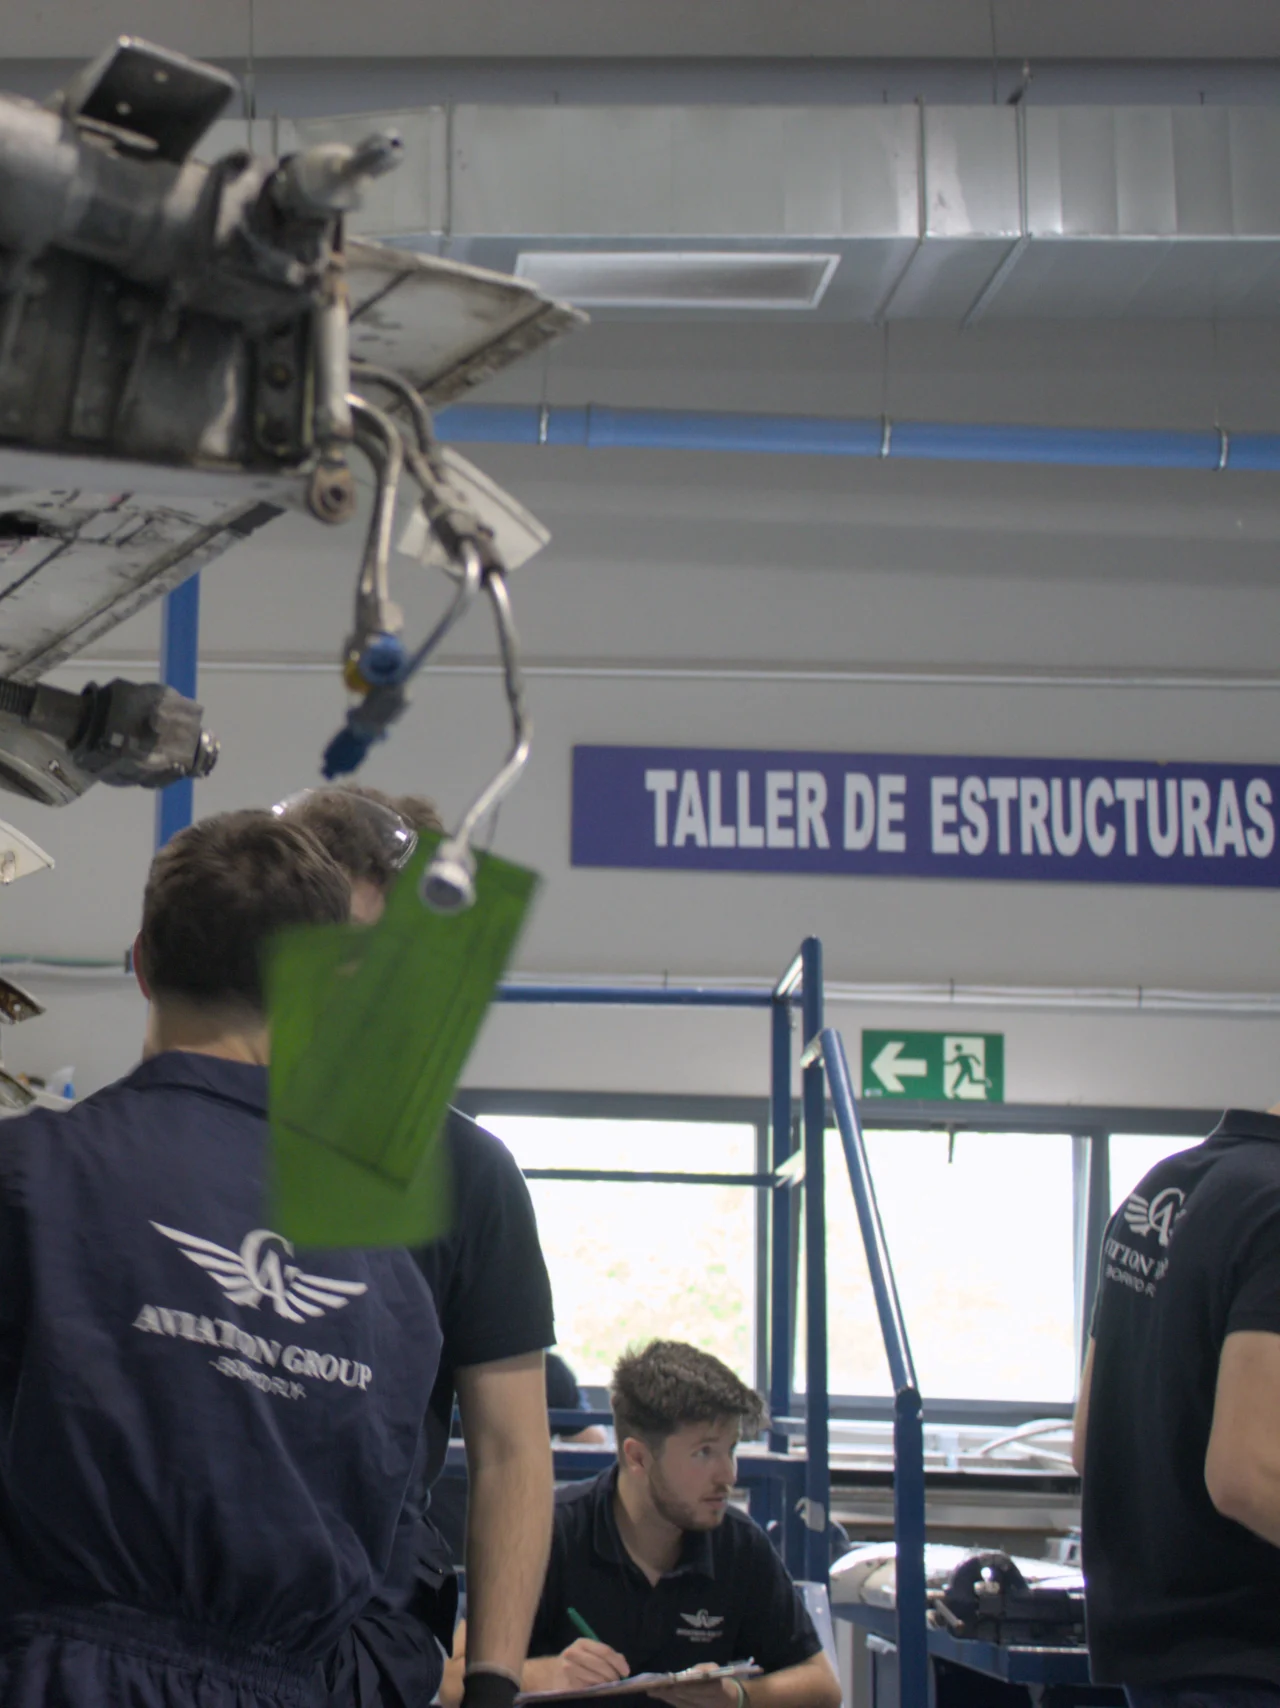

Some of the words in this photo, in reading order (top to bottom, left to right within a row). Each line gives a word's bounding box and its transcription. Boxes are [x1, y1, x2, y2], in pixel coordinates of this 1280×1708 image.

[644, 769, 830, 850] TALLER
[843, 772, 907, 853] DE
[930, 775, 1276, 859] ESTRUCTURAS
[131, 1303, 281, 1368] AVIATION
[281, 1344, 373, 1392] GROUP
